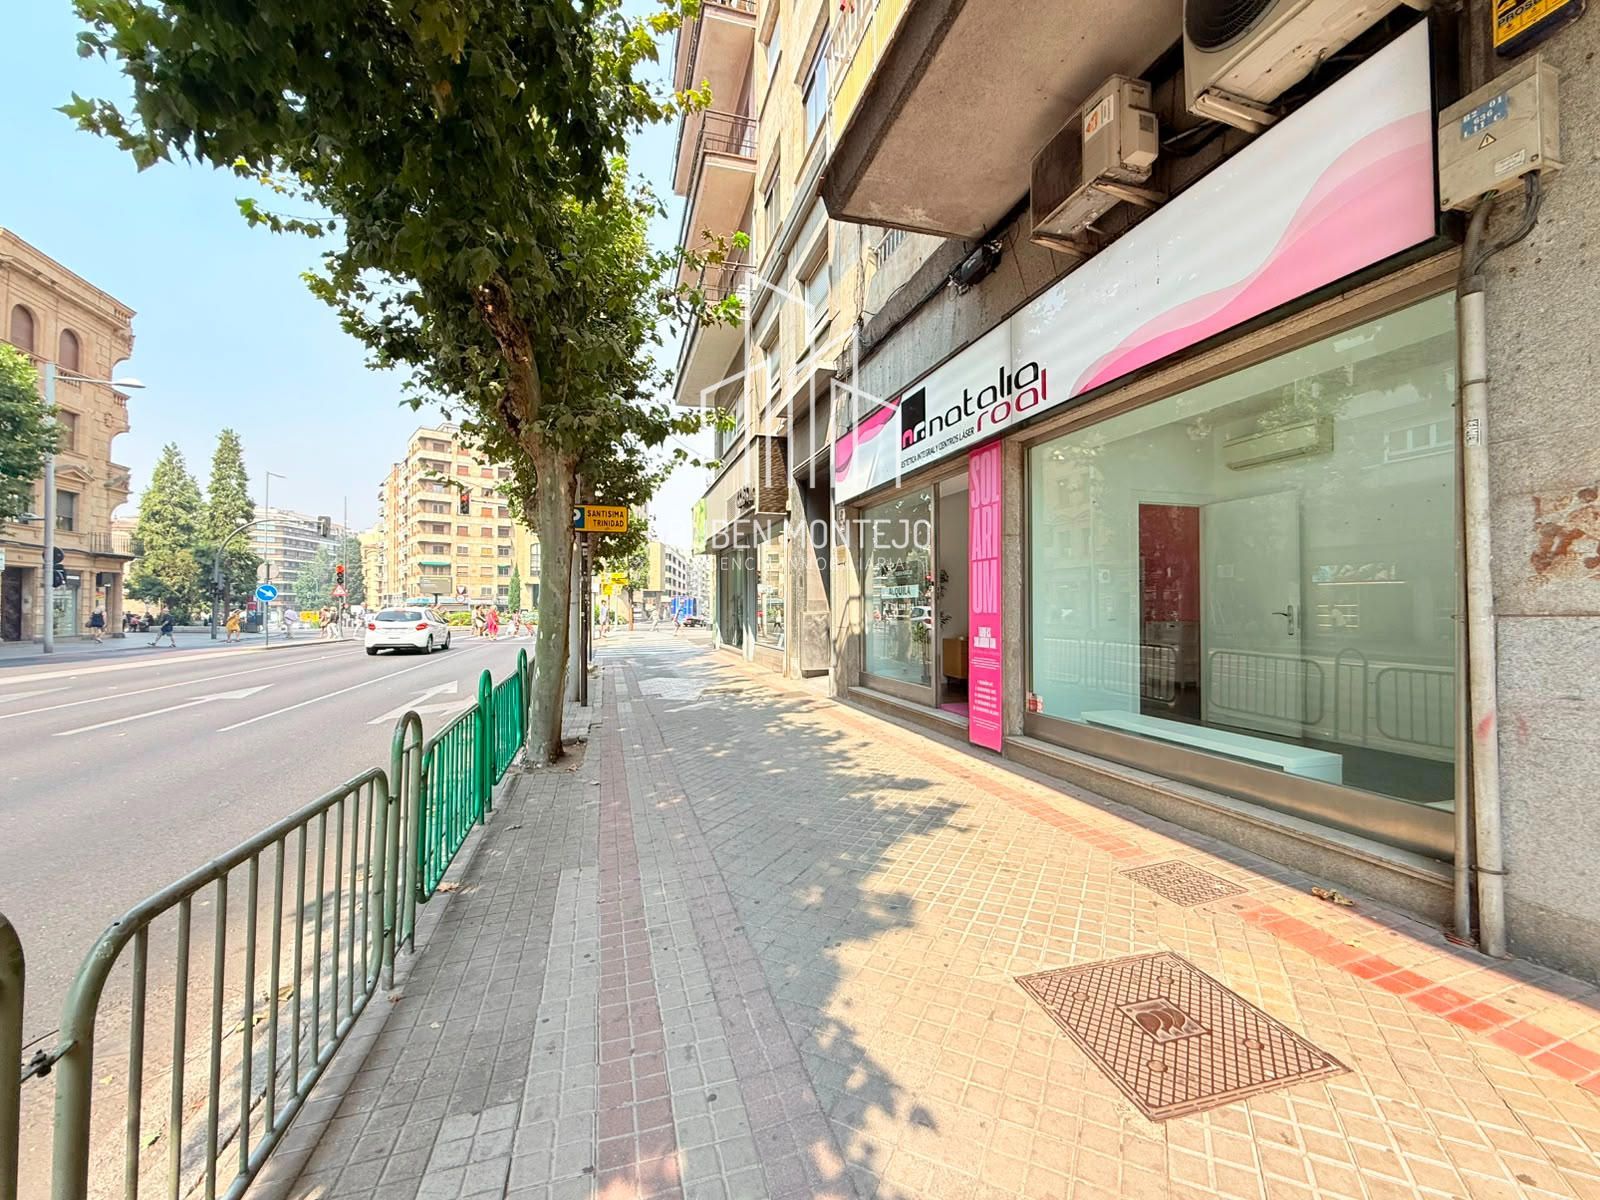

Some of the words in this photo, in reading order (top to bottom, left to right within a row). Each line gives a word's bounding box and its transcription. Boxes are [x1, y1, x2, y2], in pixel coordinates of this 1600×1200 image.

[929, 361, 1039, 436] natalia
[970, 450, 1000, 508] SOL
[593, 518, 625, 528] TRINIDAD
[971, 503, 1000, 561] ARI
[972, 560, 998, 615] UM
